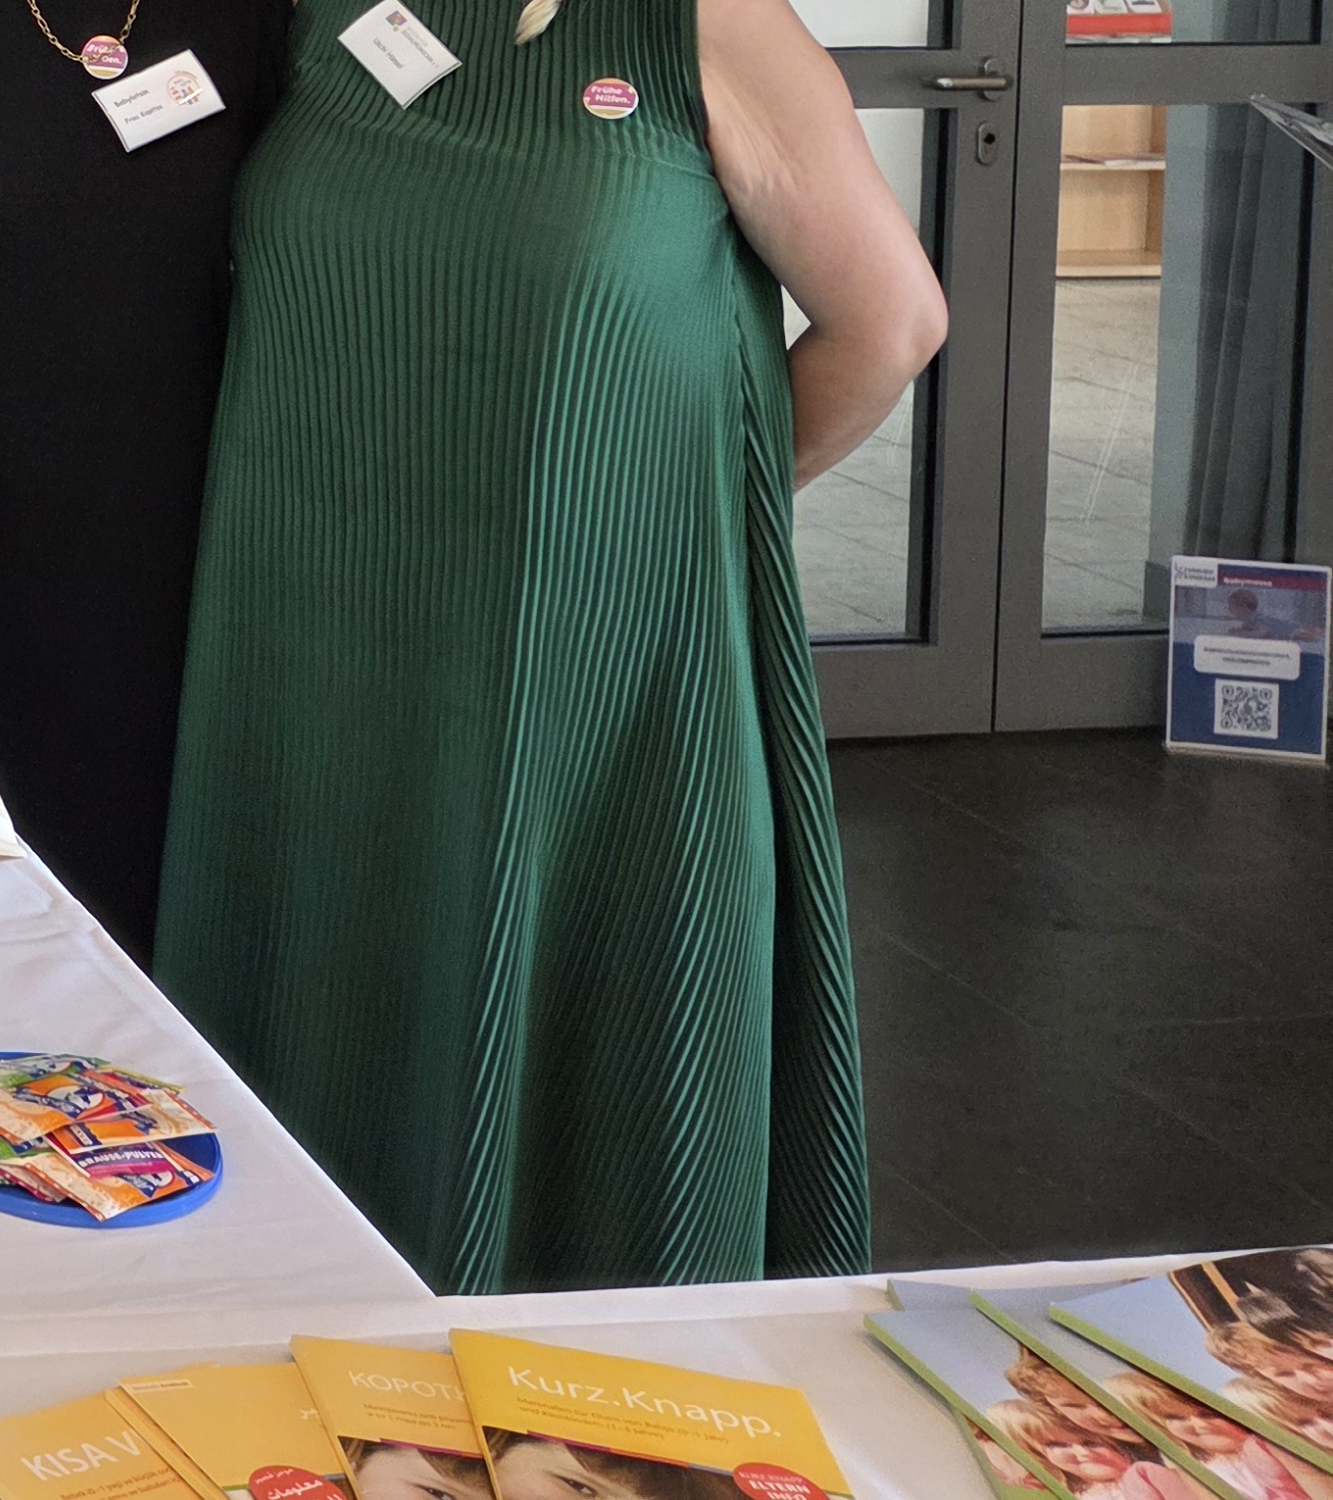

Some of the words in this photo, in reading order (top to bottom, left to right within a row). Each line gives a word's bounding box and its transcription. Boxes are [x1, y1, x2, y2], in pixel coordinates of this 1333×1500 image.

[591, 86, 623, 96] Frühe
[507, 1365, 781, 1438] Kurz.Knapp.
[20, 1442, 119, 1481] KISA
[749, 1480, 811, 1494] ELTERN
